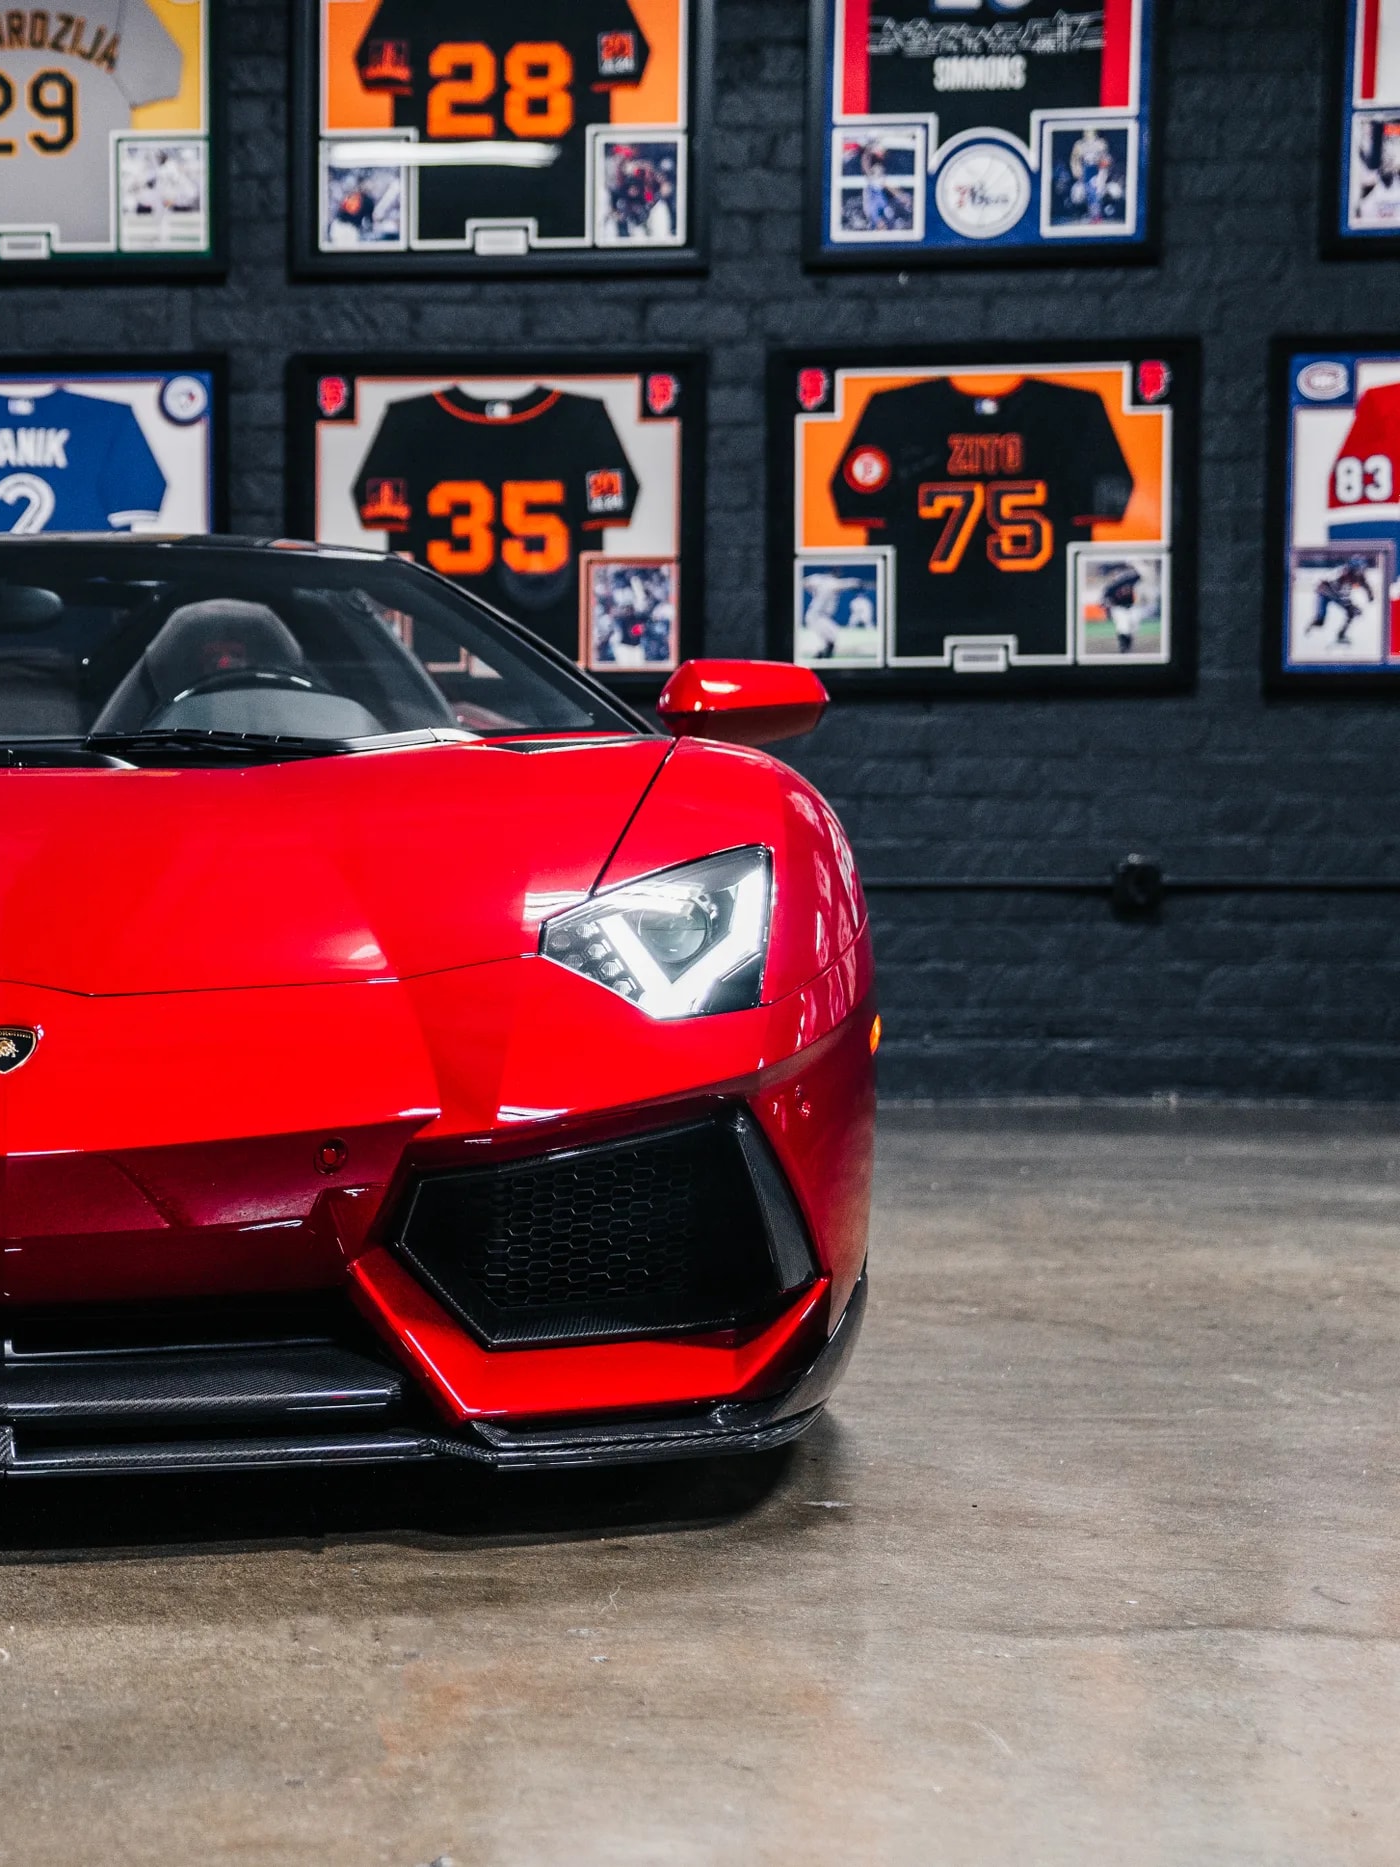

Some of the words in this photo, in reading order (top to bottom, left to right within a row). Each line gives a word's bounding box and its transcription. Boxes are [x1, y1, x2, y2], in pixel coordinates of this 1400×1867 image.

[426, 40, 573, 138] 28
[933, 55, 1027, 91] SIMMONS
[947, 432, 1022, 476] ZITO
[1335, 454, 1393, 503] 83
[427, 480, 570, 574] 35
[918, 480, 1053, 574] 75
